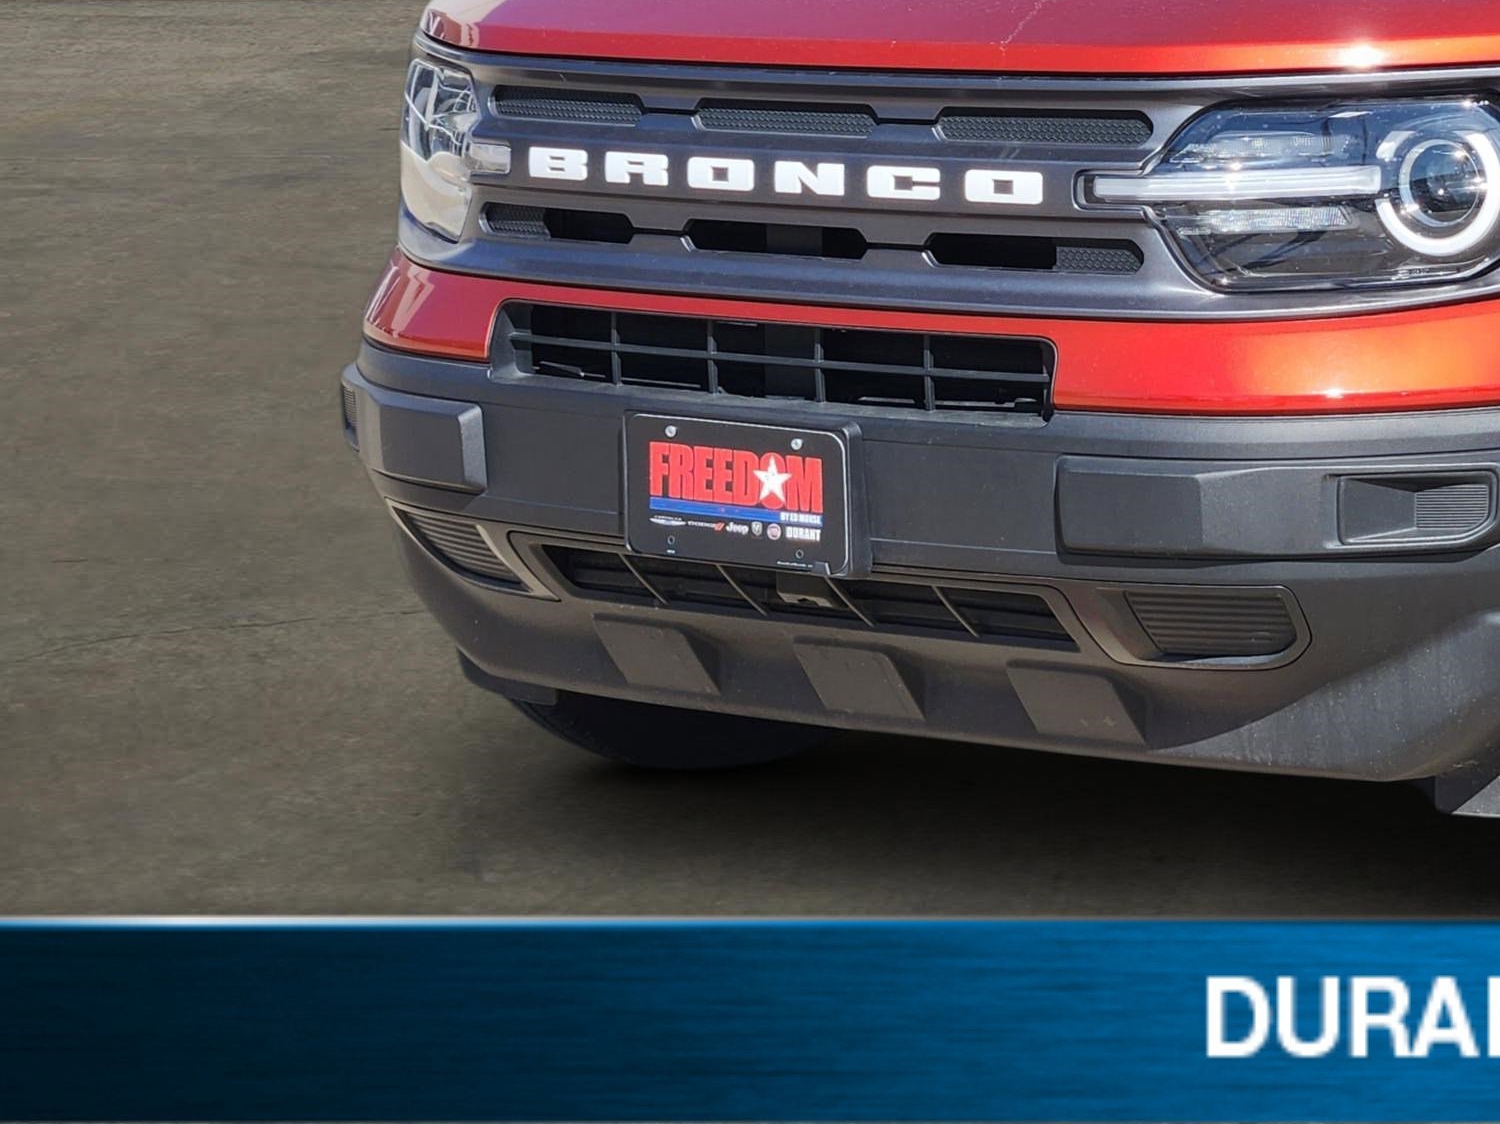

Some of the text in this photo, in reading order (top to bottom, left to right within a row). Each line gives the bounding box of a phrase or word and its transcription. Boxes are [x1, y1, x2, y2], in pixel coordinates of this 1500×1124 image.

[528, 146, 1043, 205] BRONCO
[649, 441, 824, 514] FREEDOM
[726, 521, 749, 536] Jeep
[785, 526, 822, 542] DURANT
